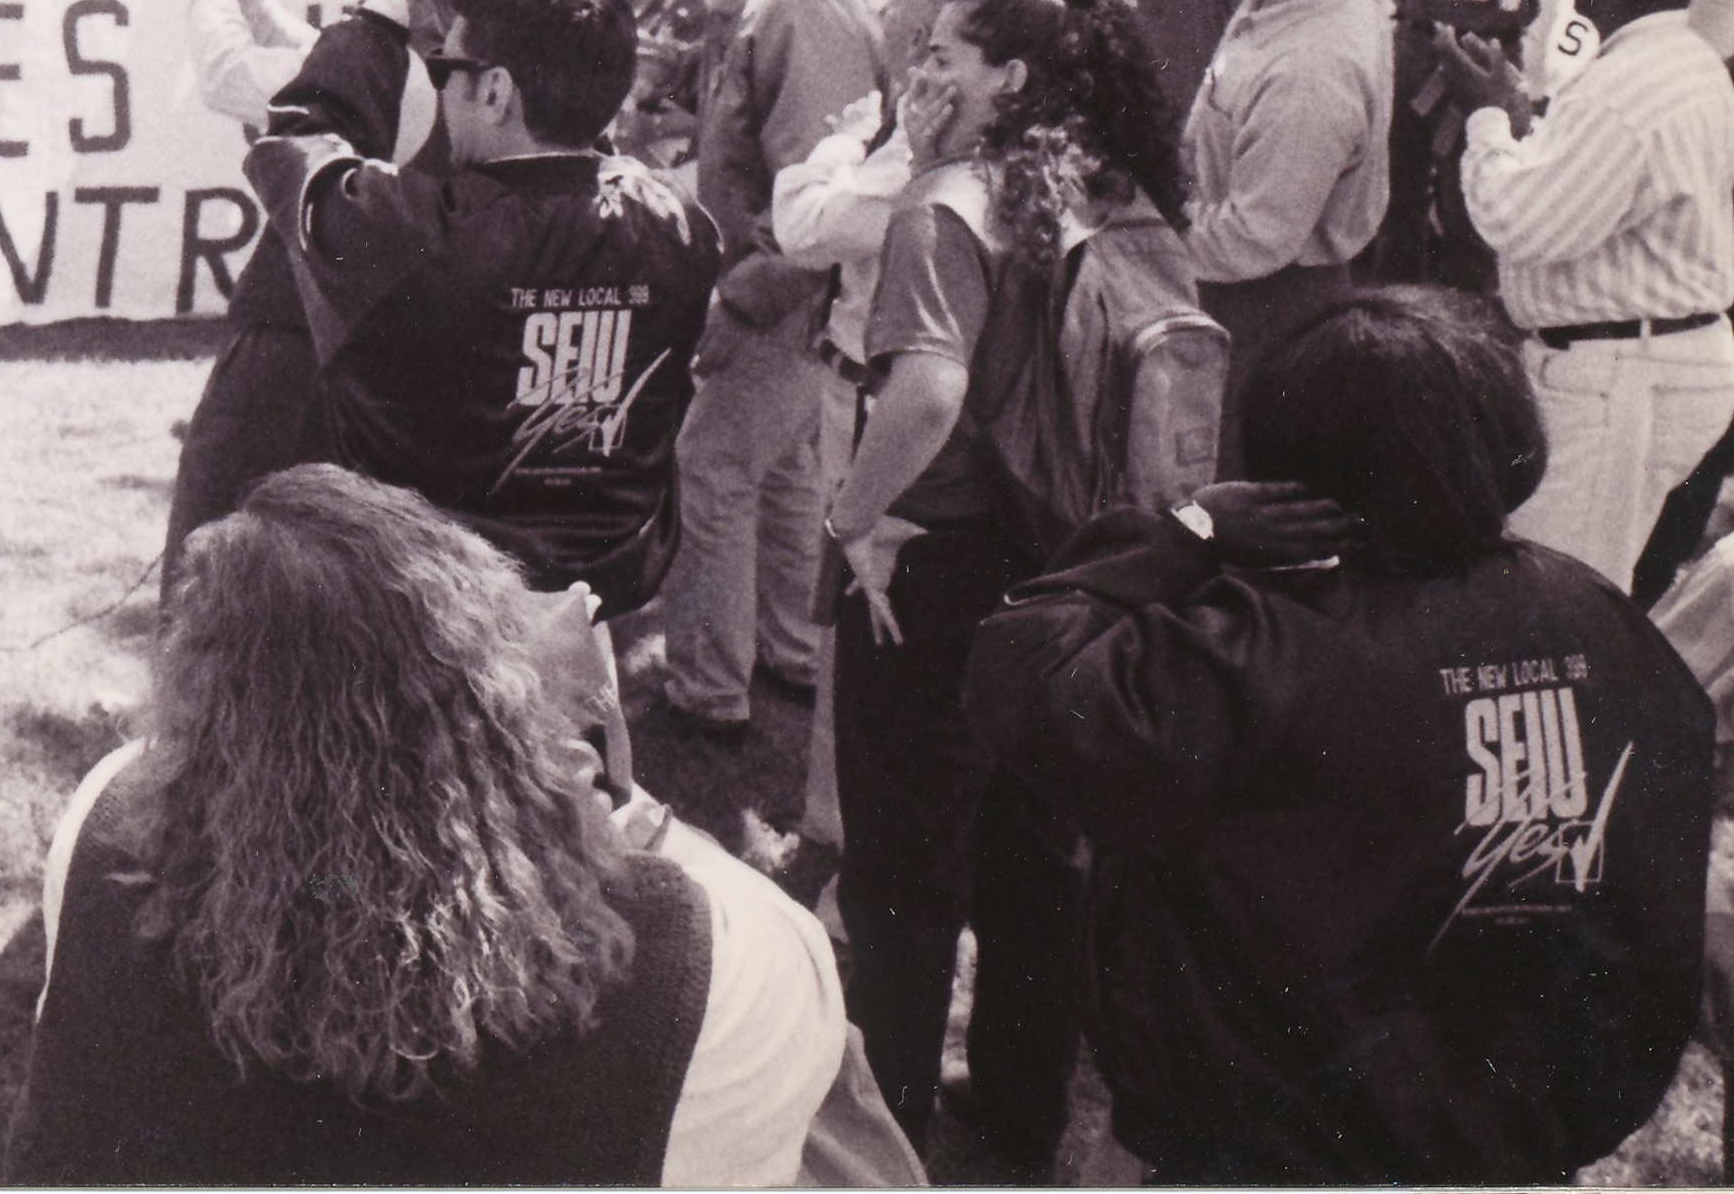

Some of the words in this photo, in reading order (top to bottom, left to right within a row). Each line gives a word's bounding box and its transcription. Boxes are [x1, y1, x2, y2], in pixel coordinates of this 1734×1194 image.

[511, 287, 537, 308] THE
[543, 288, 573, 308] NEW
[578, 286, 622, 307] LOCAL
[516, 309, 632, 406] SEIU
[1439, 666, 1473, 695] THE
[1477, 663, 1507, 691] NEW
[1512, 658, 1560, 687] LOCAL
[1465, 686, 1588, 827] SEIU
